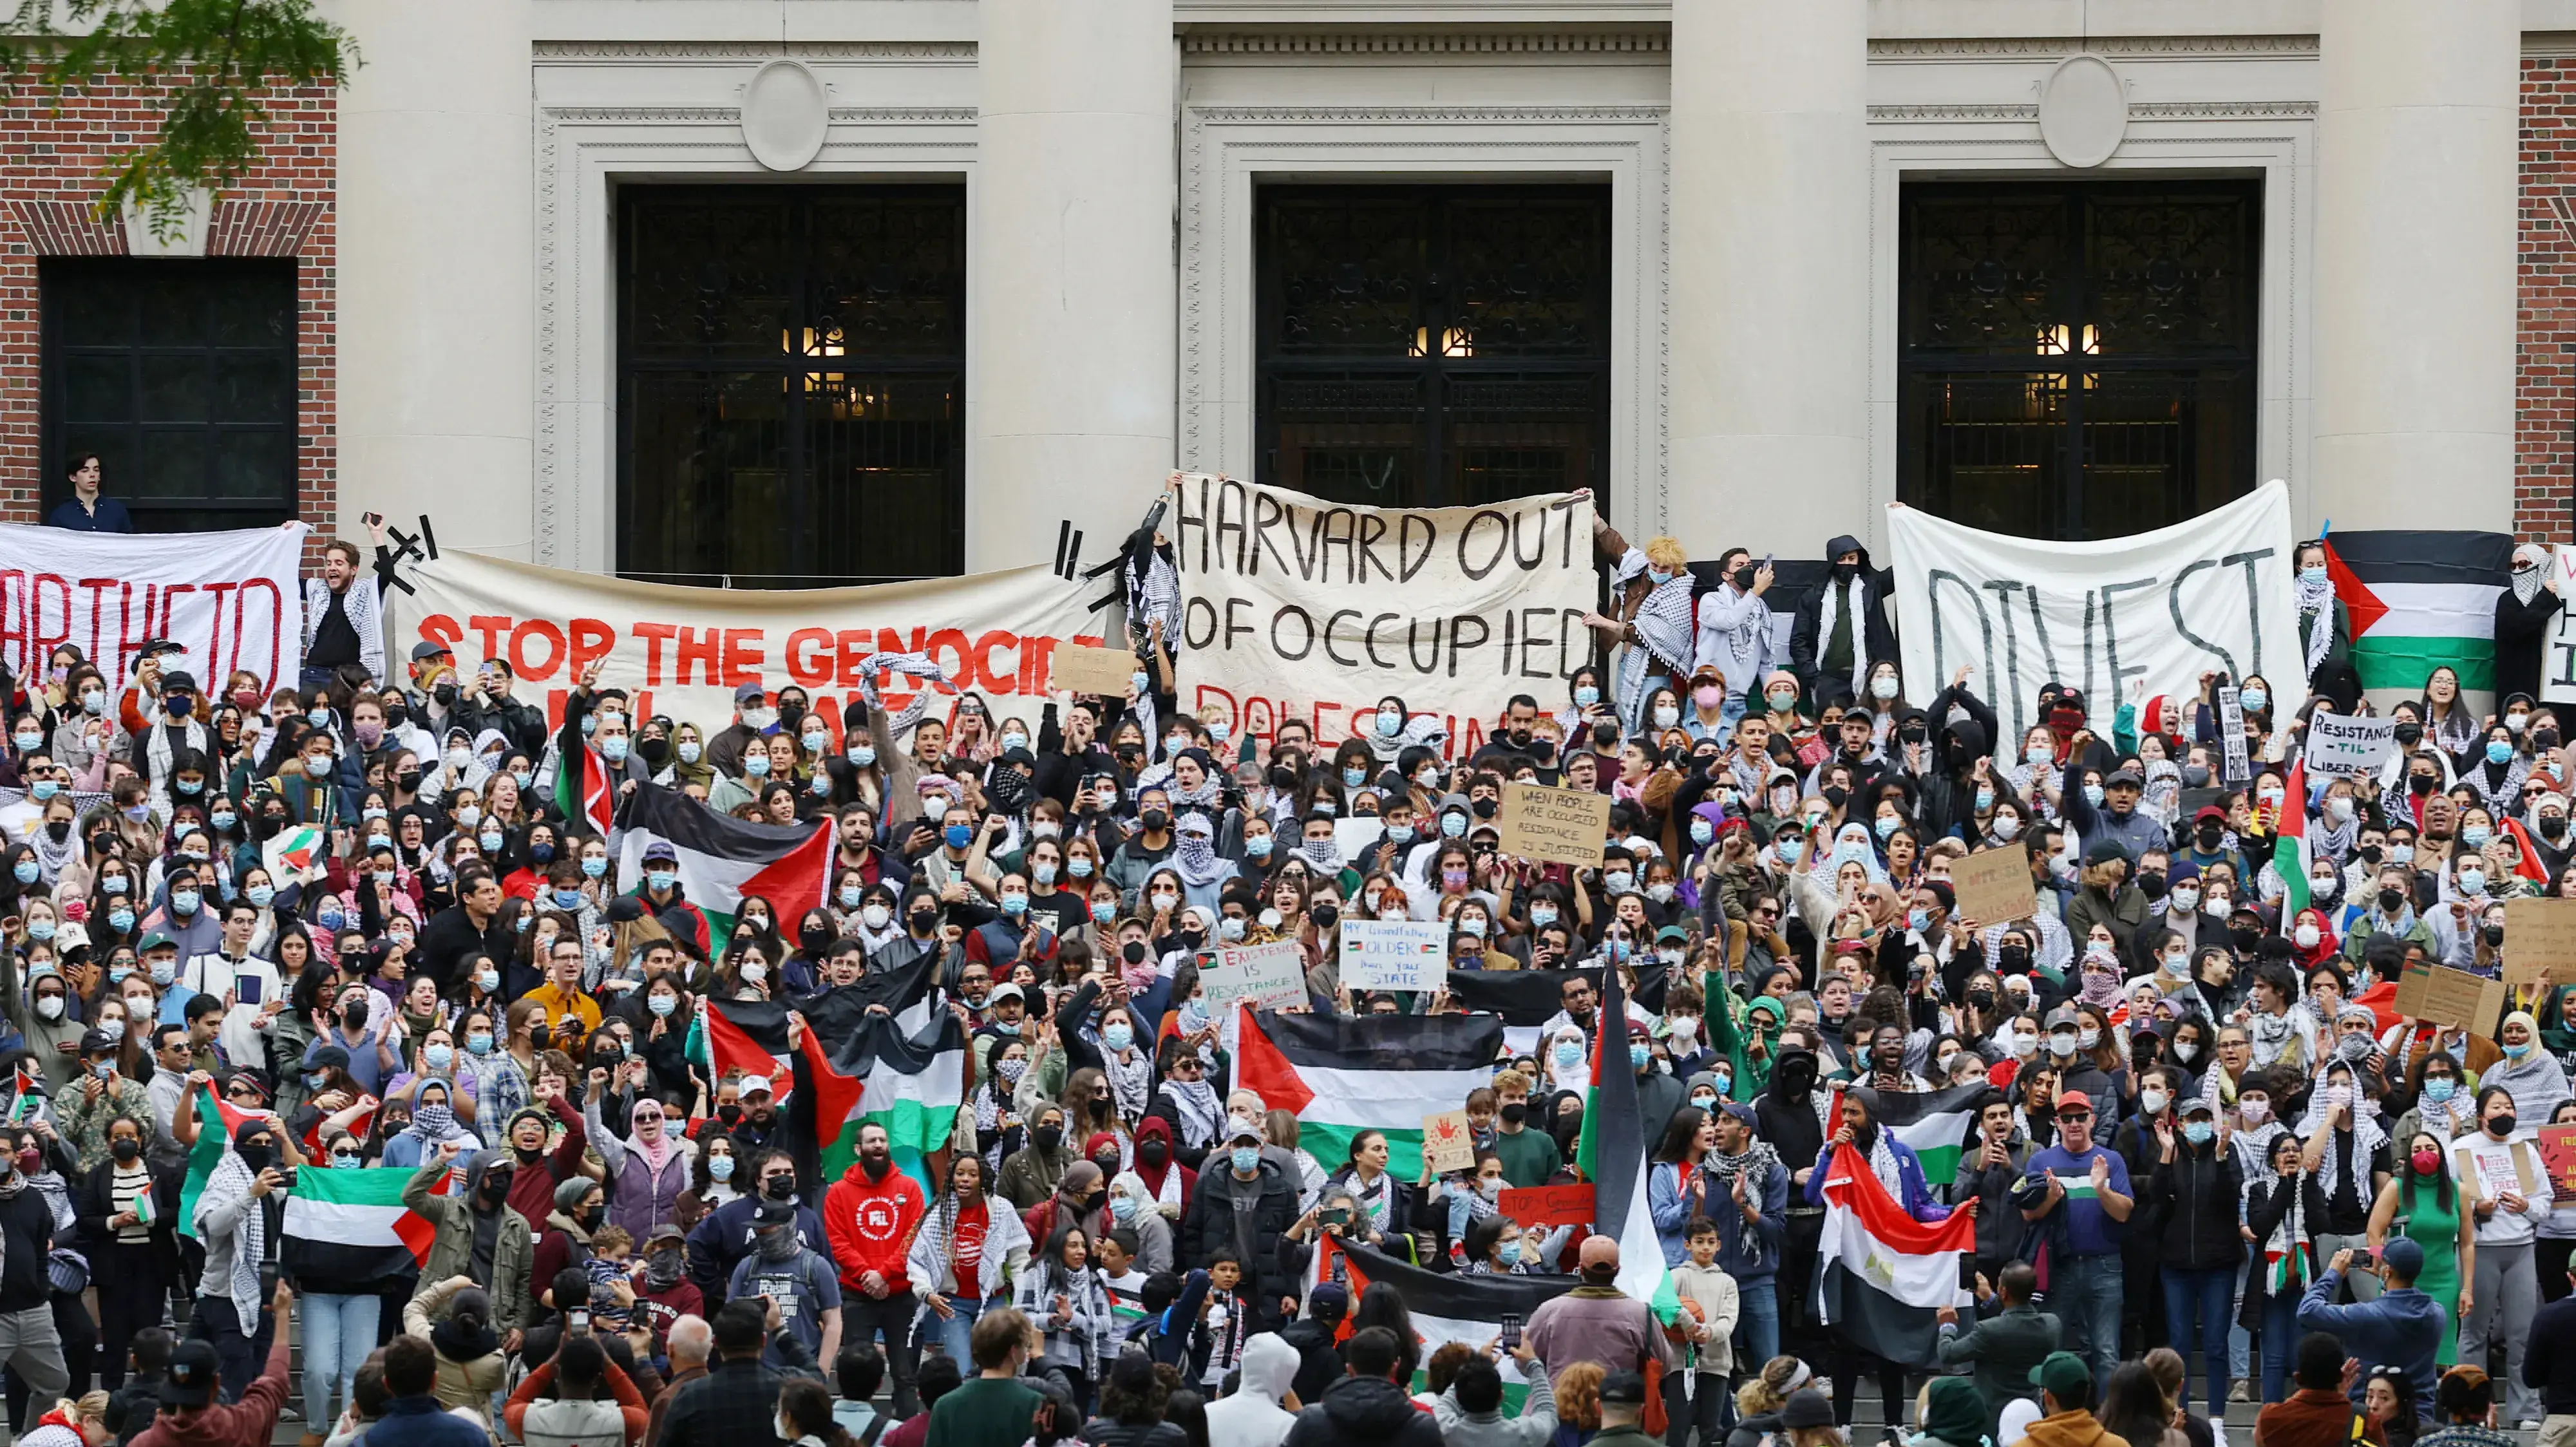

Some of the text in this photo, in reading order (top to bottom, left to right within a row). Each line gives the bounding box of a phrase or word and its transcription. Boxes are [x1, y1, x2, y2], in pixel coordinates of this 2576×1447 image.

[1176, 478, 1591, 584] HARVARD OUT
[1184, 596, 1595, 680] OF OCCUPIED
[408, 613, 1104, 697] STOP THE GENOCID
[2338, 742, 2366, 754] TIL
[1520, 790, 1595, 812] WHEN PEOPLE
[1520, 805, 1545, 818] ARE
[1518, 822, 1580, 840] RESISTANCE
[1520, 840, 1533, 851] IS
[1343, 922, 1361, 934] MY
[1224, 943, 1297, 966] EXISTENCE
[1366, 940, 1417, 956] OLDER
[1244, 963, 1261, 978] IS
[1434, 1149, 1473, 1168] GAZA
